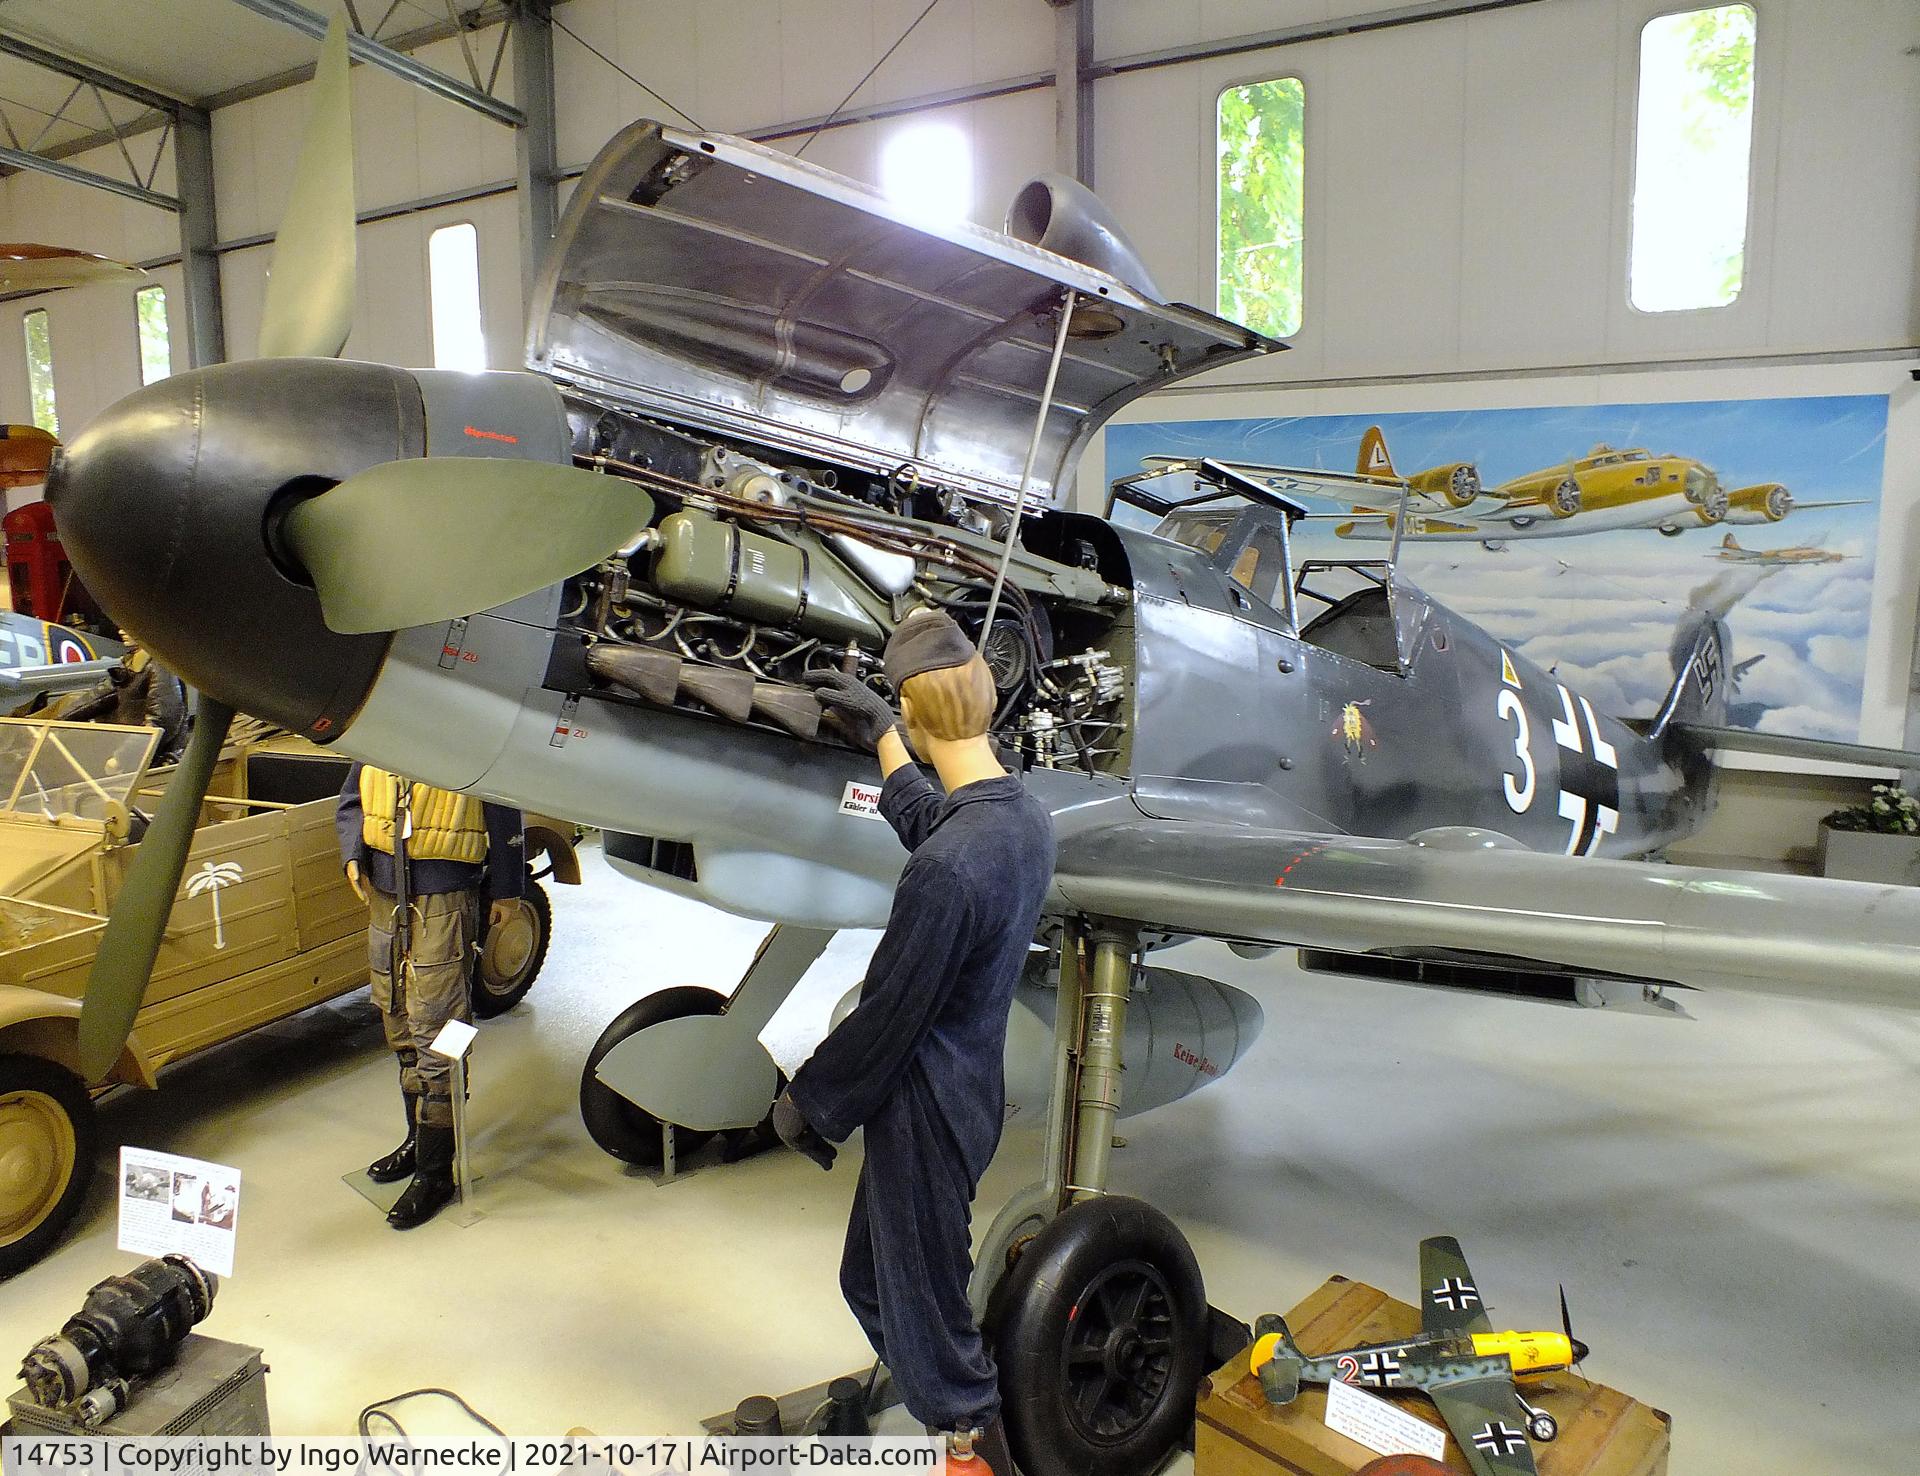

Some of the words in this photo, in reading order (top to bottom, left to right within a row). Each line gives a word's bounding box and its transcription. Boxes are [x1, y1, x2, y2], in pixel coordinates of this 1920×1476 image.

[1376, 448, 1385, 463] L
[1497, 688, 1536, 815] 3
[852, 788, 880, 803] Vorsi
[1337, 1355, 1361, 1386] 2
